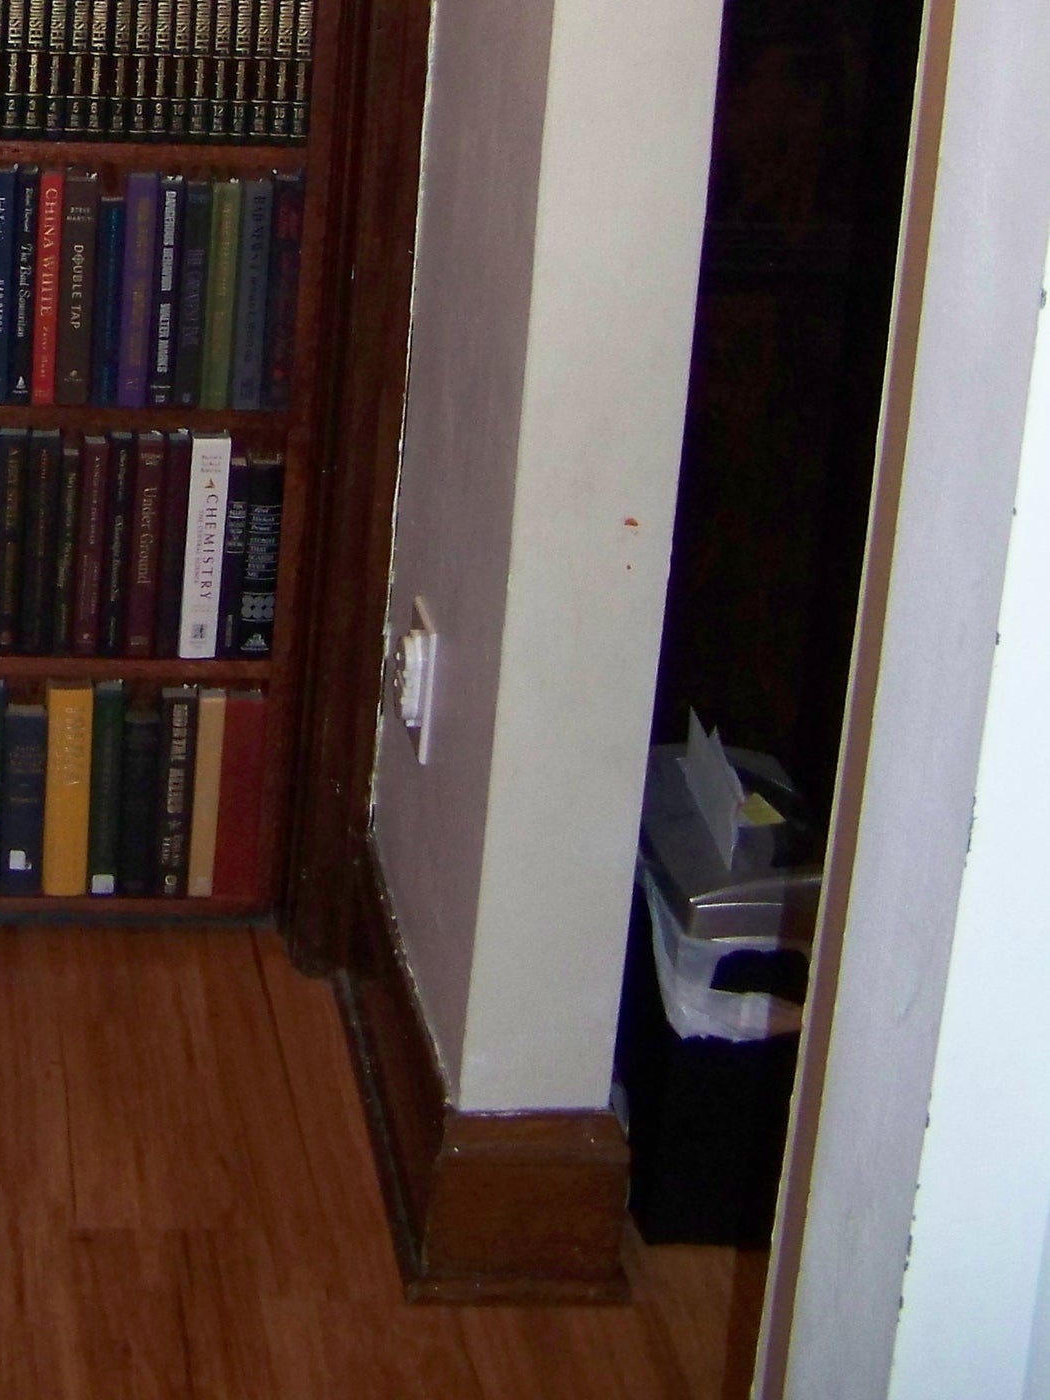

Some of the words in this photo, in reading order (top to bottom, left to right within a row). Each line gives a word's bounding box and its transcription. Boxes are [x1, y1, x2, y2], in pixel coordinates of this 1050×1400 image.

[155, 102, 163, 115] 9
[42, 186, 59, 250] CHINA
[161, 190, 178, 246] DANGEROUS
[19, 242, 33, 262] The
[69, 242, 86, 300] DOUBLE
[17, 264, 33, 287] Bad
[38, 255, 56, 318] WHITE
[69, 303, 83, 331] TAP
[157, 302, 172, 339] WALTER
[155, 339, 171, 374] MARKS
[142, 486, 158, 527] Under
[136, 532, 155, 586] Ground
[198, 493, 220, 601] CHEMISTRY
